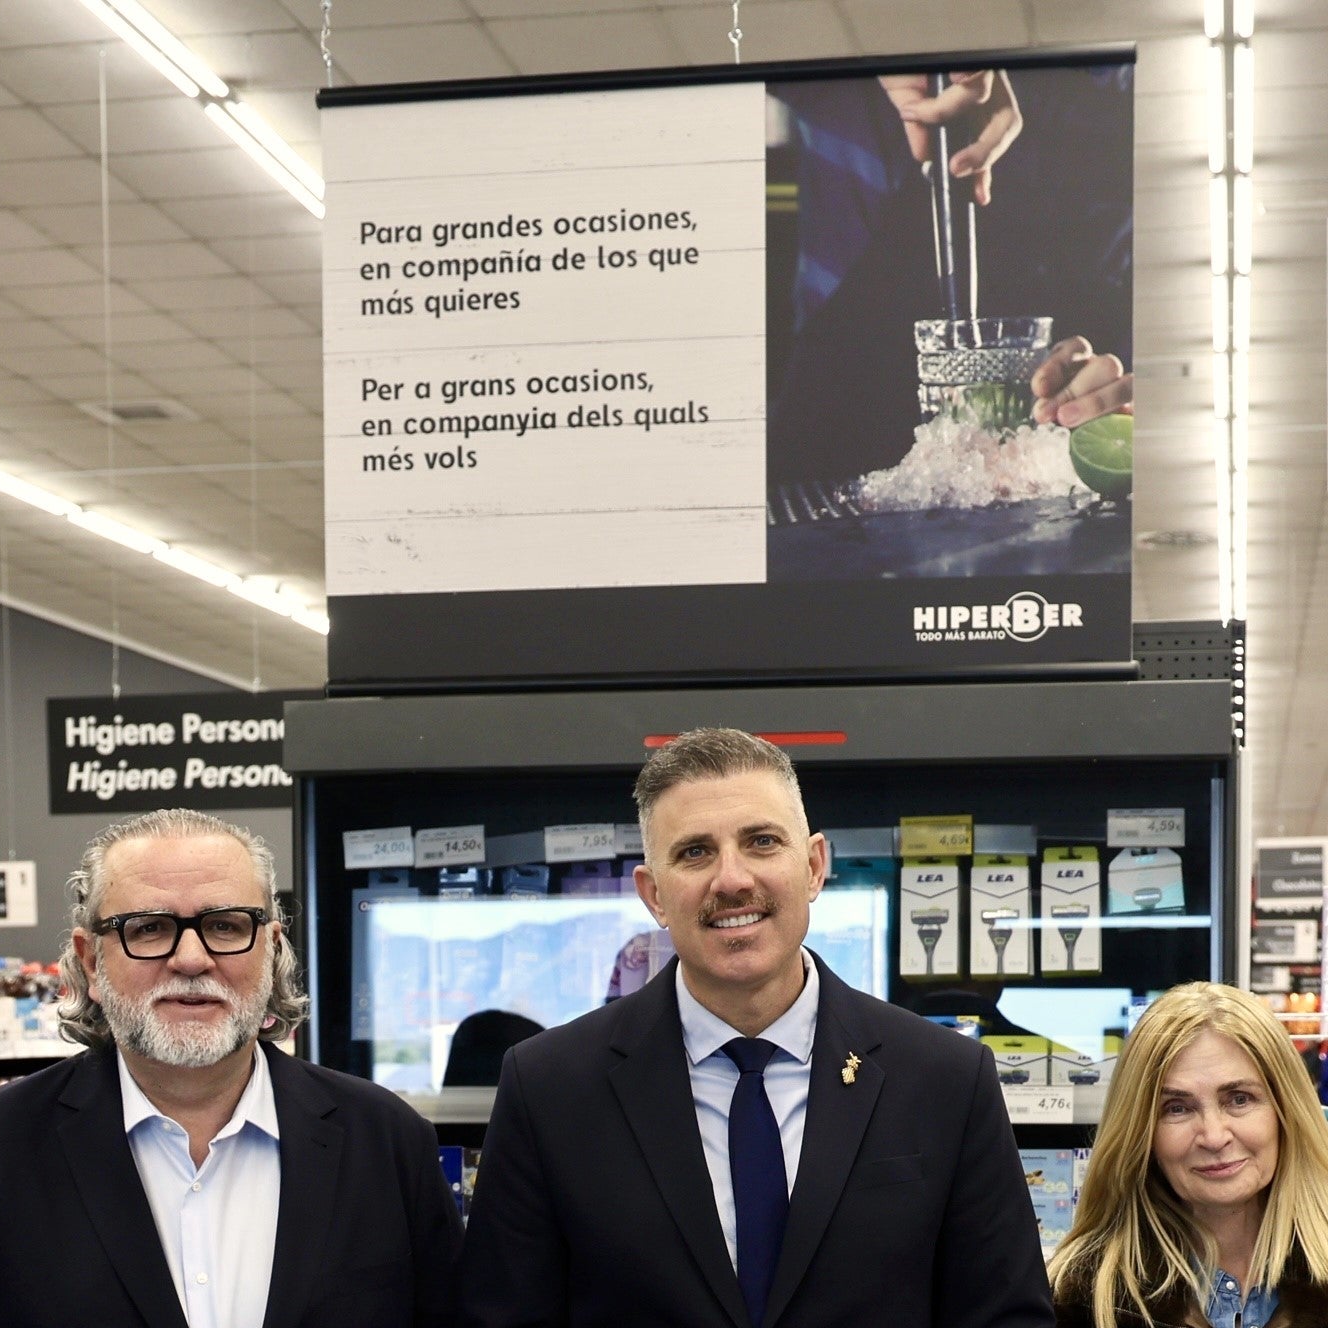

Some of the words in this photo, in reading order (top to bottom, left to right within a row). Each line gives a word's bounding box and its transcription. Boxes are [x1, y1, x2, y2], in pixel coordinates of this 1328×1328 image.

[360, 222, 422, 246] Para
[432, 214, 543, 247] grandes
[553, 209, 698, 236] ocasiones,
[359, 259, 391, 280] en
[401, 248, 541, 281] compañía
[551, 246, 586, 271] de
[597, 246, 638, 269] los
[647, 243, 699, 272] que
[360, 290, 414, 316] más
[424, 287, 521, 319] quieres
[361, 377, 405, 401] Per
[414, 381, 431, 399] a
[440, 375, 516, 404] grans
[525, 368, 654, 395] ocasions,
[361, 415, 392, 437] en
[403, 405, 558, 439] companyia
[566, 404, 624, 429] dels
[633, 401, 709, 431] quals
[362, 445, 414, 471] més
[424, 445, 478, 471] vols
[913, 599, 1084, 634] HIPERBER
[916, 631, 943, 642] TODO
[945, 629, 966, 641] MÁS
[968, 630, 1006, 641] BARATO
[65, 714, 176, 755] Higiene
[67, 759, 178, 801] Higiene
[917, 874, 944, 883] LEA
[987, 874, 1014, 883] LEA
[1057, 869, 1085, 879] LEA
